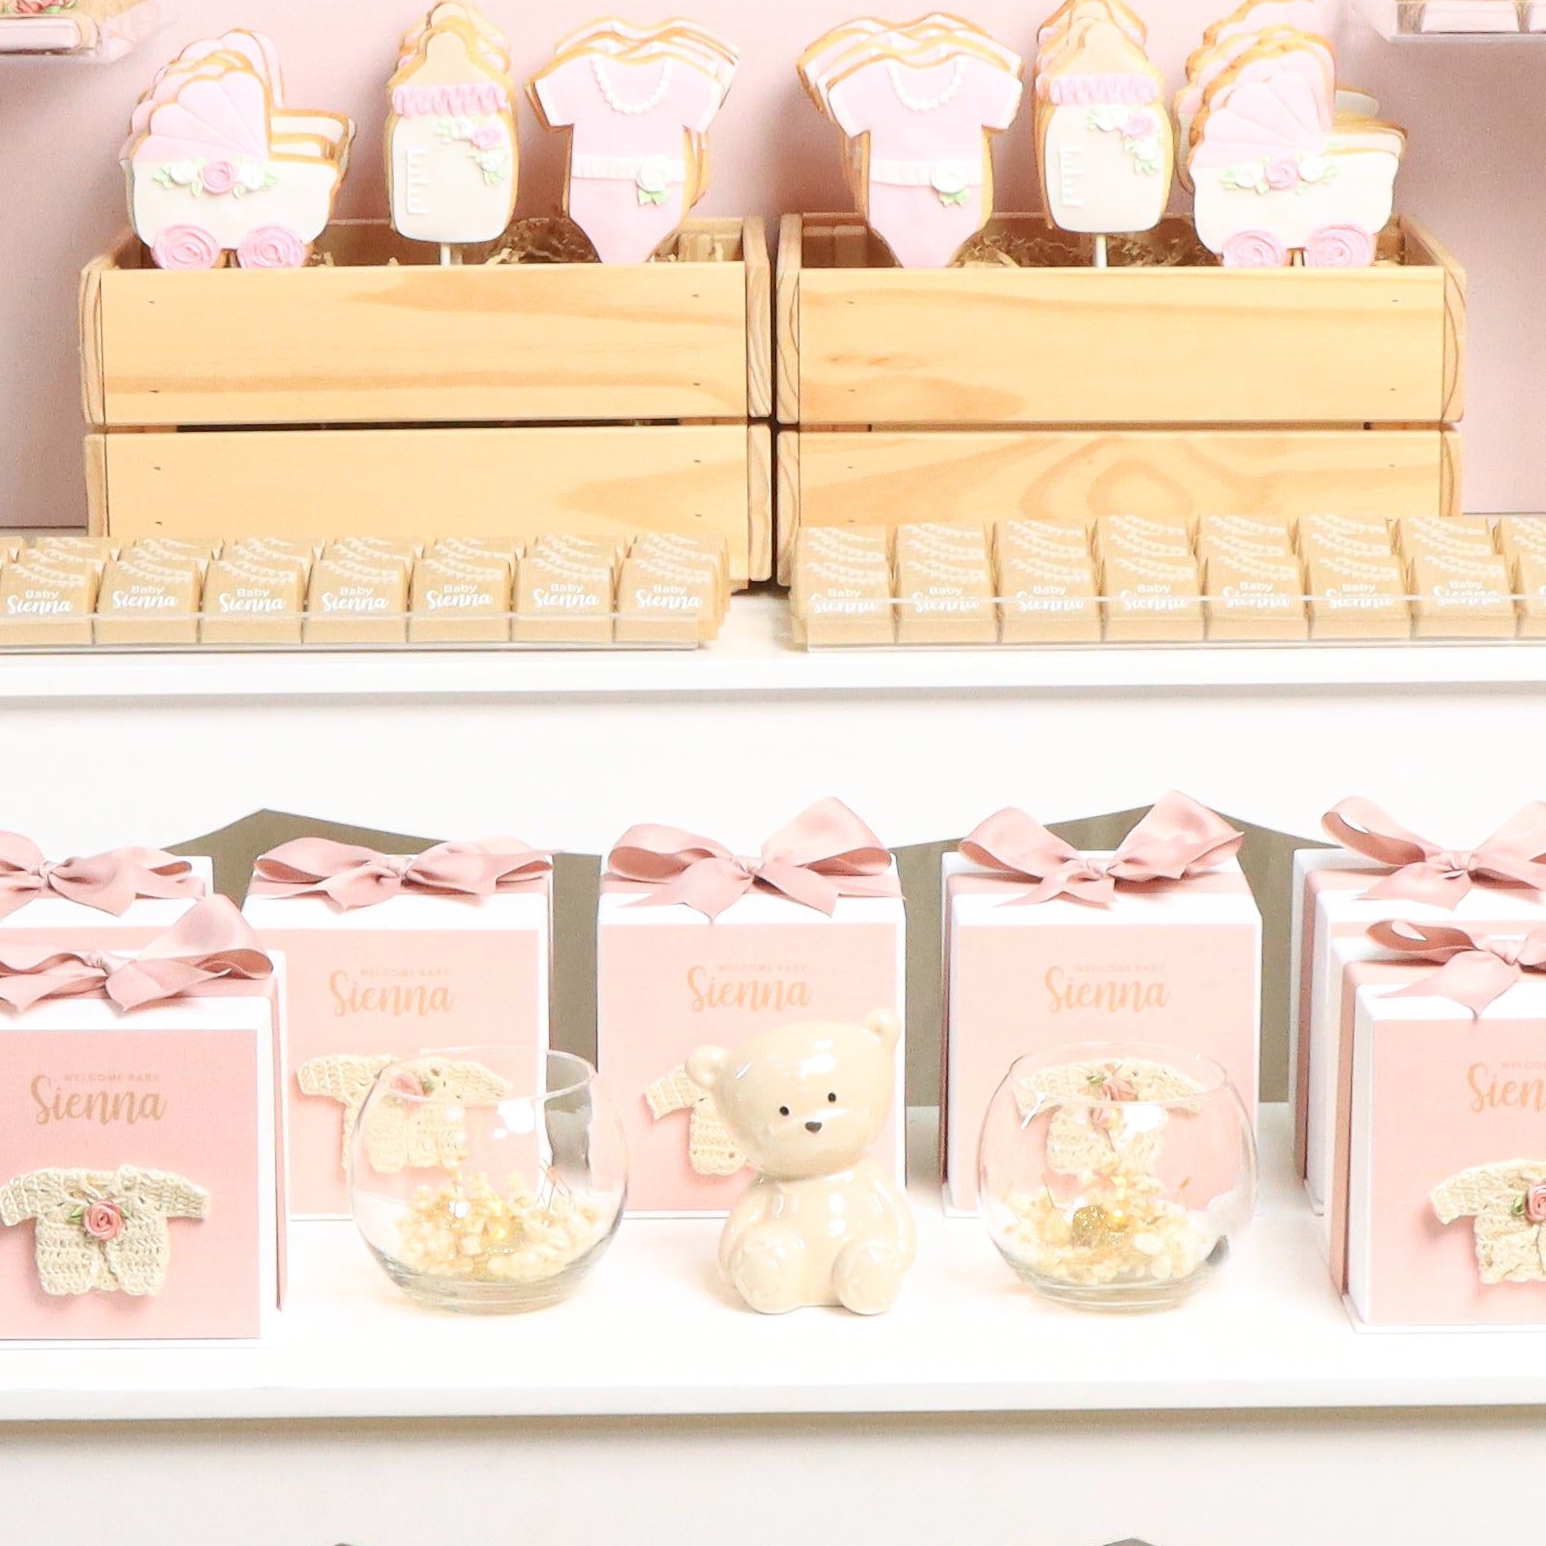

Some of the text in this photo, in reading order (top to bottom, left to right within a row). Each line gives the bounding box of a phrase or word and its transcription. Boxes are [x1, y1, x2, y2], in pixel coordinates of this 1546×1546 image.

[131, 585, 165, 596] Baby
[443, 584, 477, 595] Baby
[550, 582, 584, 594] Baby
[652, 584, 686, 595] Baby
[929, 585, 963, 596] Baby
[1032, 585, 1067, 596] Baby
[1137, 584, 1171, 595] Baby
[1239, 581, 1273, 593] Baby
[1341, 583, 1375, 594] Baby
[1449, 580, 1483, 591] Baby
[24, 589, 59, 600] Baby
[236, 587, 271, 598] Baby
[339, 586, 373, 598] Baby
[533, 587, 599, 608] Sienna
[827, 588, 861, 599] Baby
[6, 595, 72, 613] Sienna
[113, 590, 179, 610] Sienna
[218, 593, 285, 613] Sienna
[321, 592, 388, 612] Sienna
[426, 589, 492, 610] Sienna
[635, 589, 702, 610] Sienna
[360, 968, 451, 977] WELCOME BABY
[717, 964, 772, 972] WELCOME
[1075, 965, 1165, 973] WELCOME BABY
[329, 969, 454, 1017] Sienna
[686, 965, 812, 1013] Sienna
[1044, 965, 1171, 1013] Sienna
[63, 1073, 161, 1082] WELCOME BABY
[30, 1073, 168, 1125] Sienna
